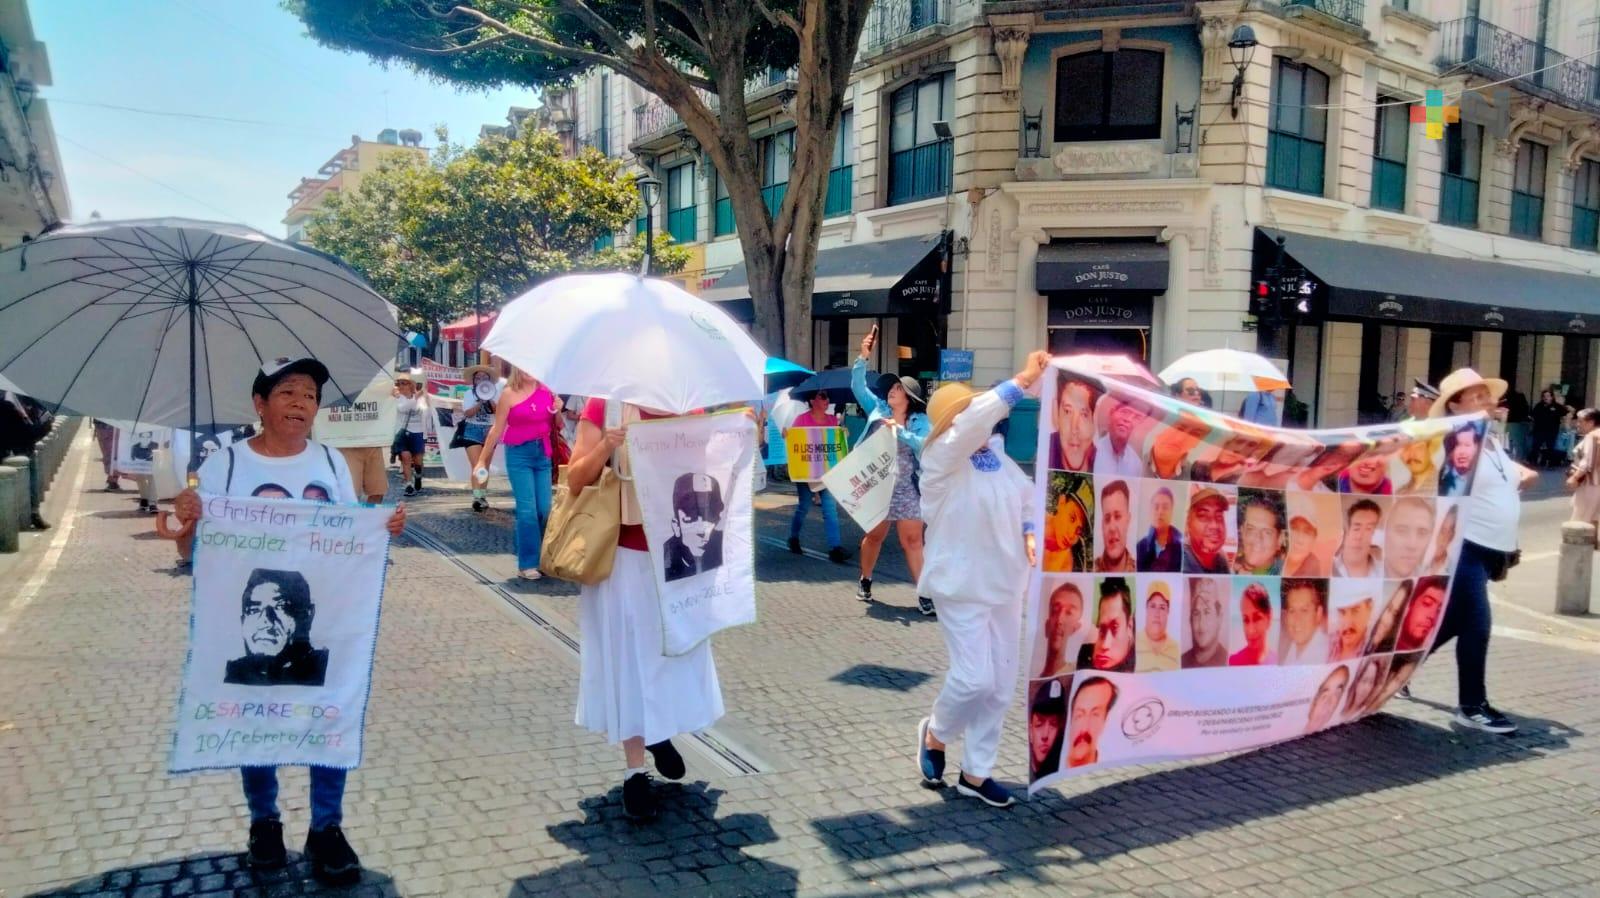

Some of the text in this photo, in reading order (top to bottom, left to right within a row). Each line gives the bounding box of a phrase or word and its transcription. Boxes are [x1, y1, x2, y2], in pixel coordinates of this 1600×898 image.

[1075, 271, 1128, 283] DON JUSTO
[902, 286, 918, 296] DON
[1065, 305, 1132, 319] DON JUSTO
[354, 401, 378, 412] MAYO
[794, 444, 799, 453] A
[309, 531, 365, 556] Rueda
